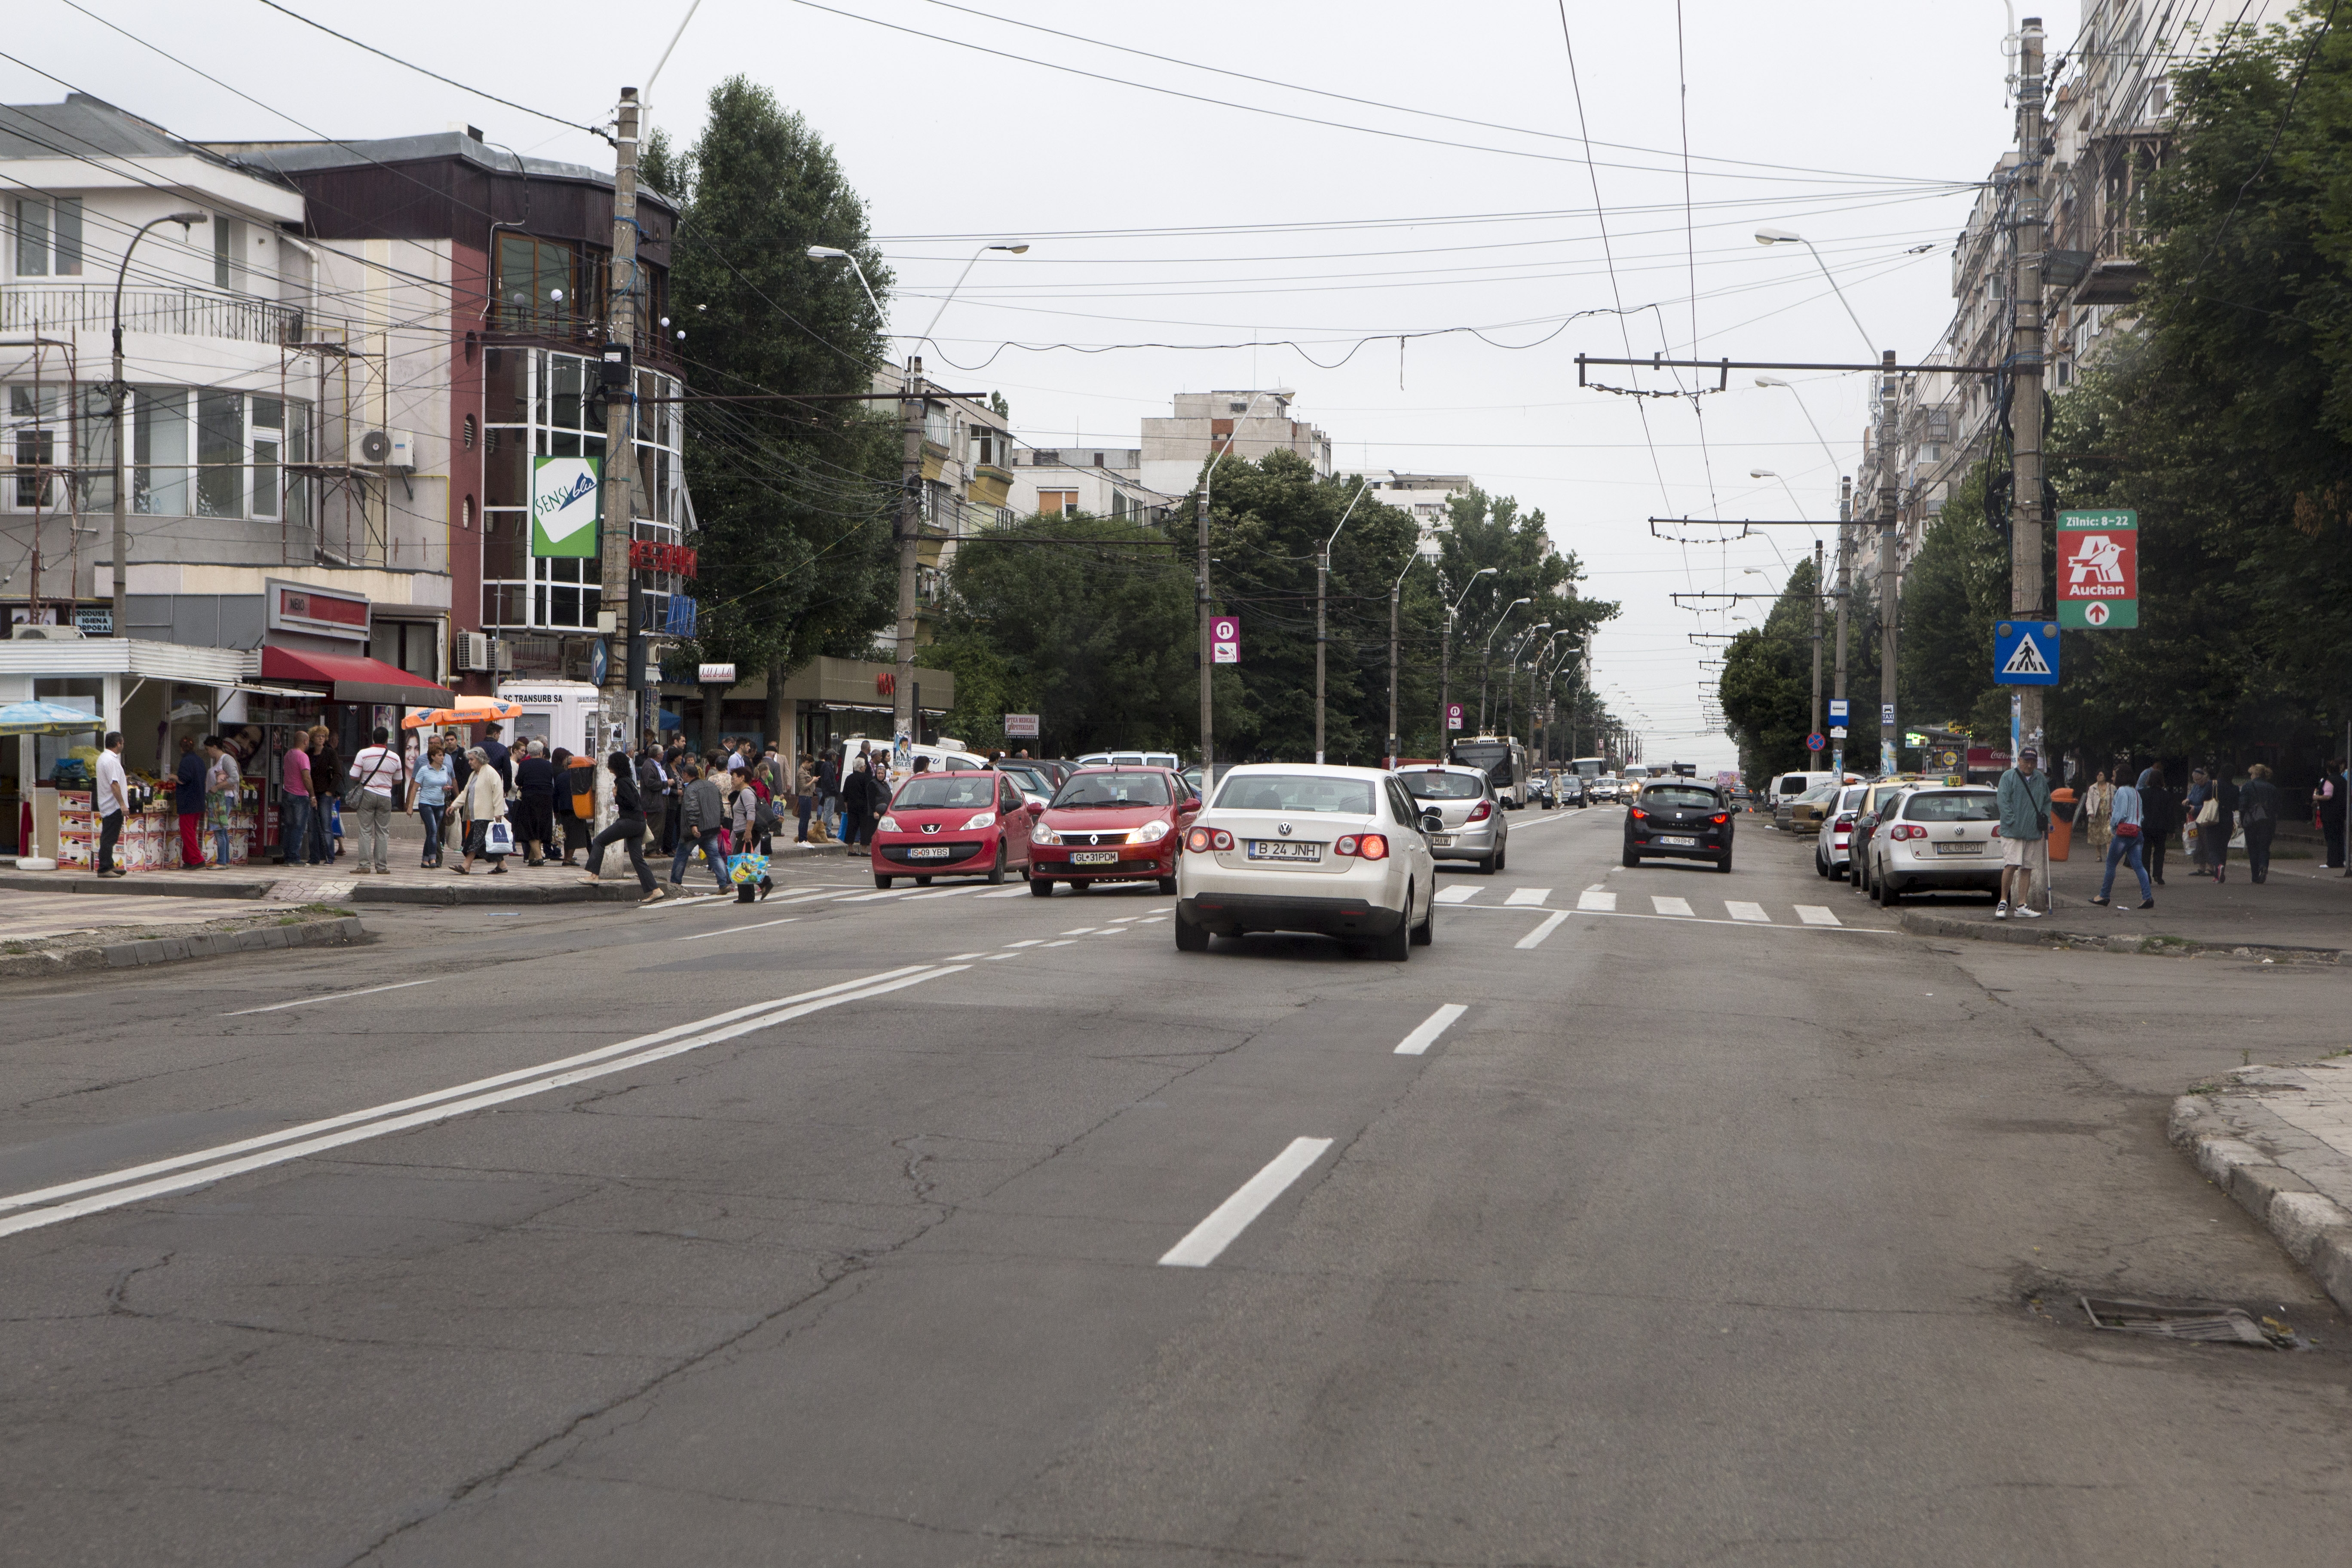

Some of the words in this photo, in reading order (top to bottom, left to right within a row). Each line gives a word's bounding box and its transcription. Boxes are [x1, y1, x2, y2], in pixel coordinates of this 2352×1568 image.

[2066, 517, 2098, 527] Zilnic:
[2069, 585, 2125, 595] Auchan
[1259, 843, 1268, 854] B
[1273, 844, 1286, 854] 24
[1292, 844, 1315, 856] JNH
[1076, 853, 1087, 861] GL
